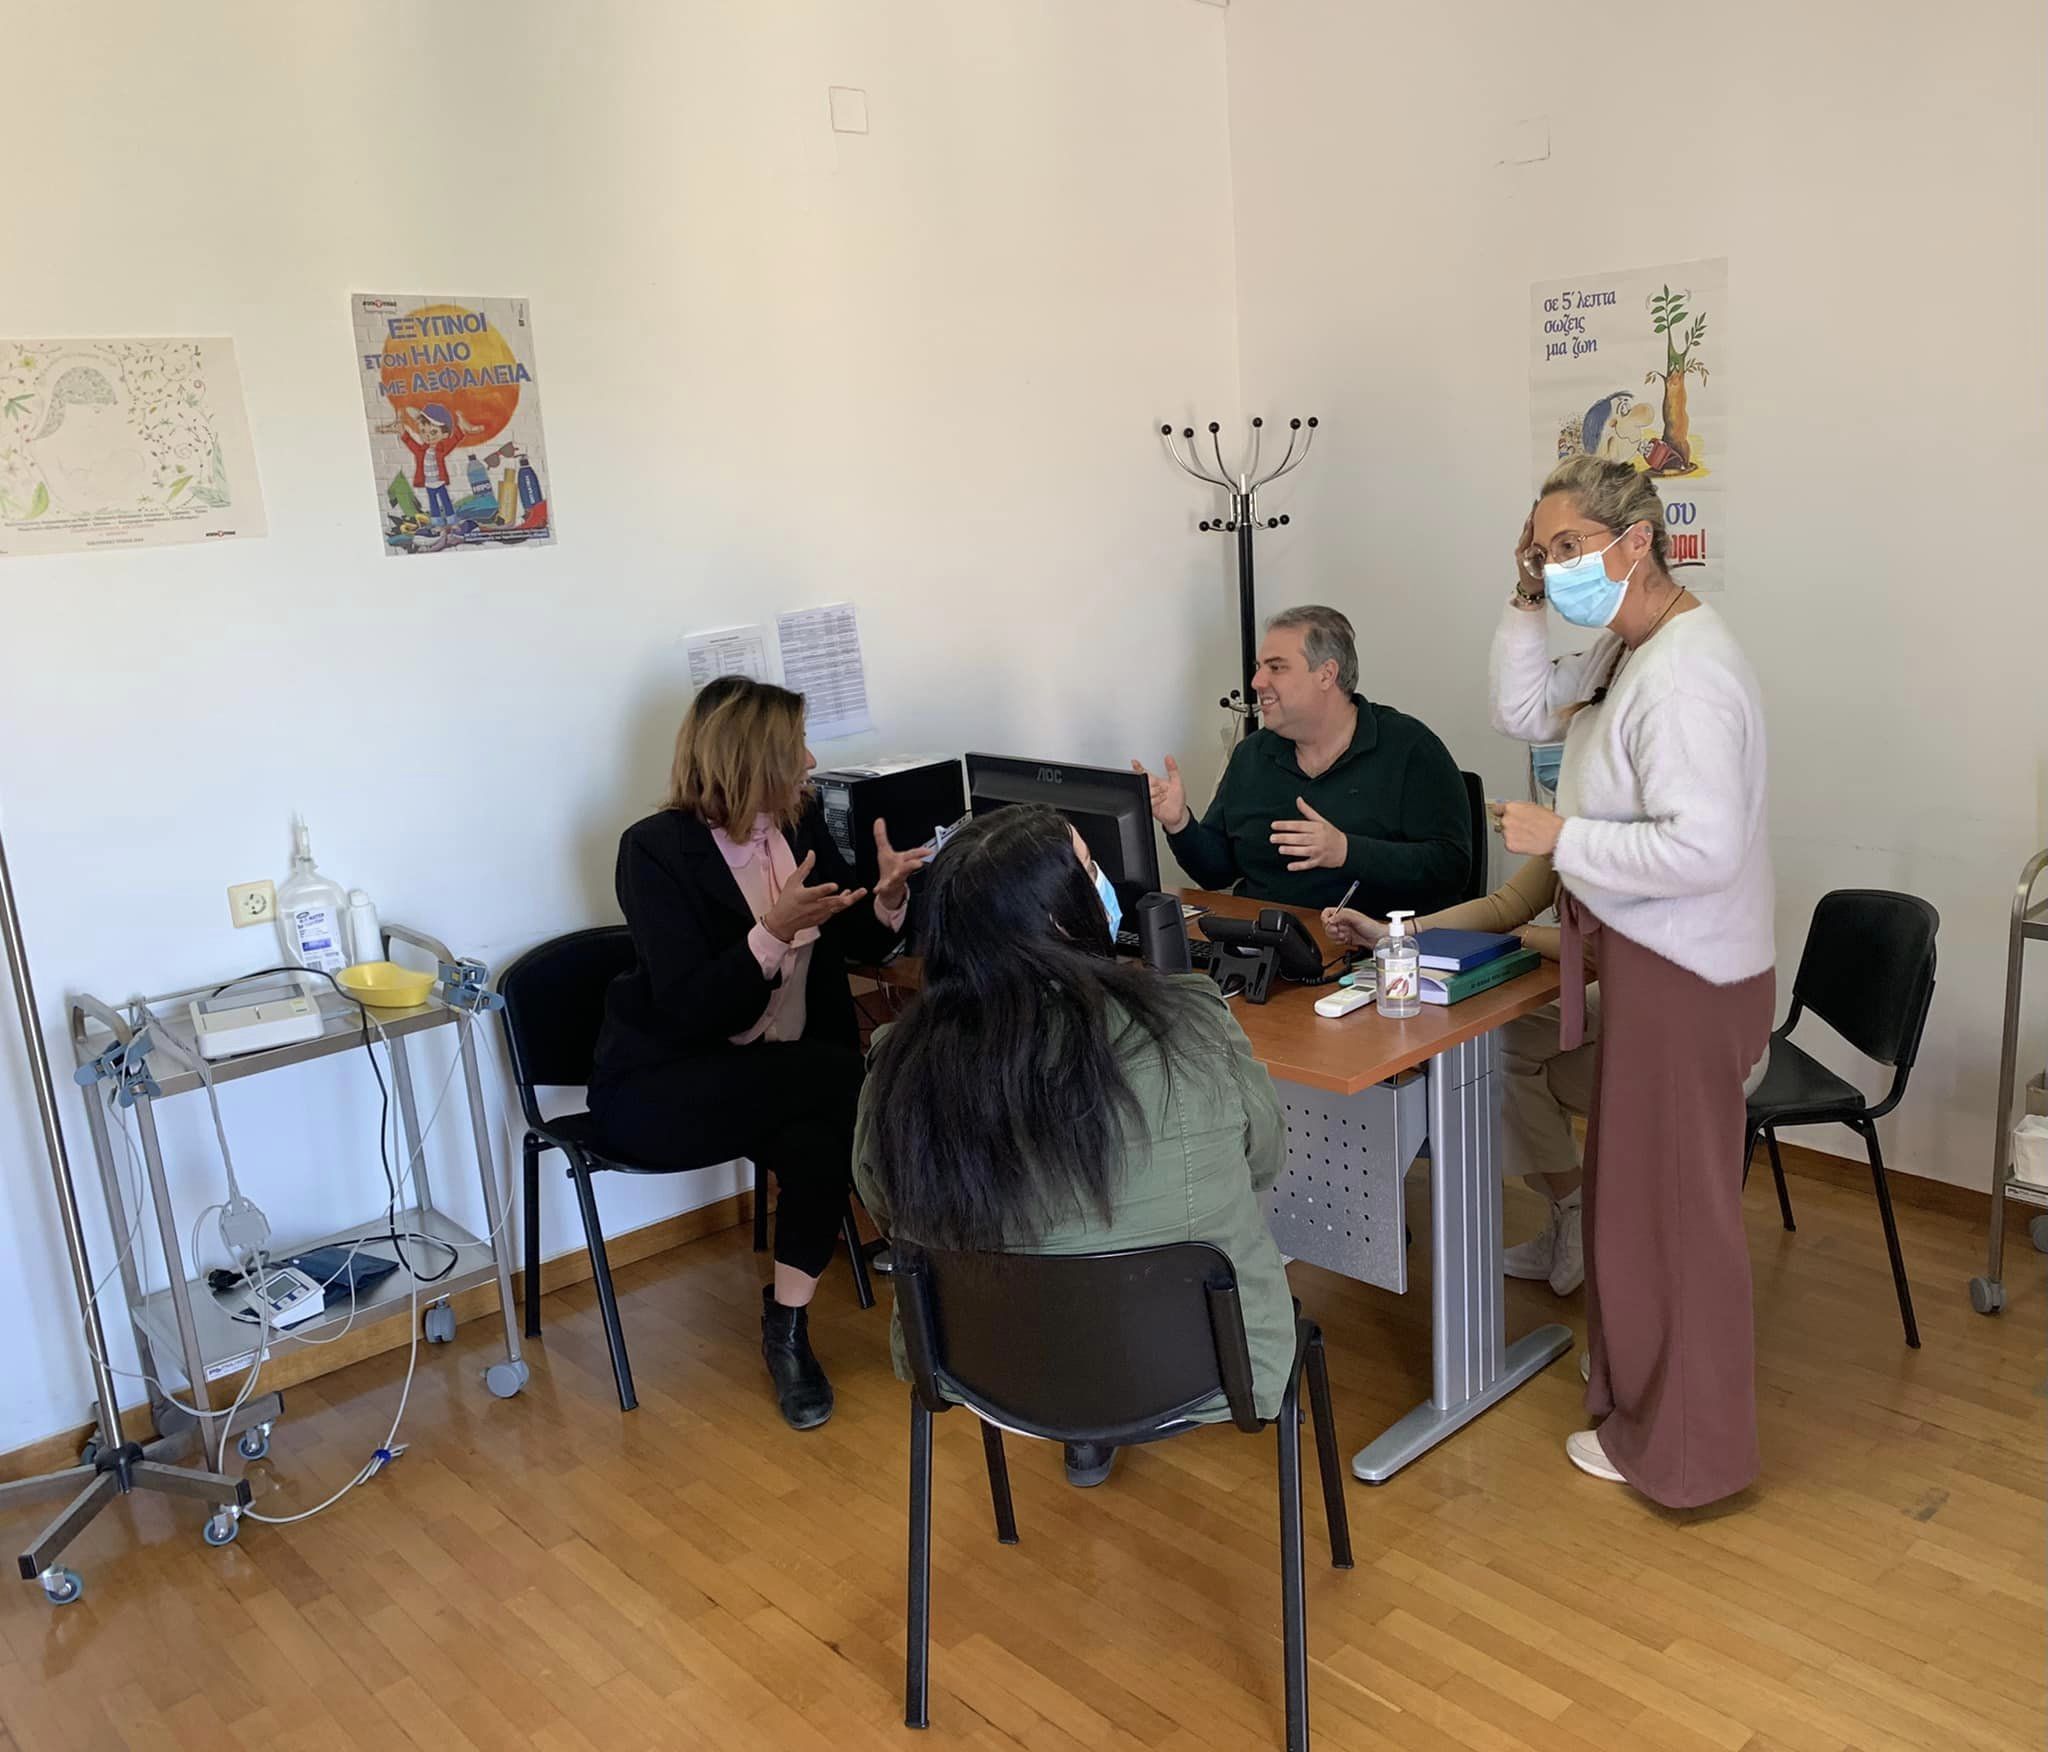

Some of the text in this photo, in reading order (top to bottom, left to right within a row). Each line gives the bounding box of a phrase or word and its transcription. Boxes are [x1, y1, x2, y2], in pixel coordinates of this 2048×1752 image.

[1544, 298, 1559, 313] σε
[1577, 290, 1616, 309] λεπτα
[387, 312, 488, 339] ΕΞΥΠΝΟΙ
[1544, 314, 1585, 336] σωζεις
[364, 342, 471, 370] ΣΤΟΝ ΗΛΙΟ
[1546, 336, 1597, 361] μια ζωη
[378, 363, 531, 397] ΜΕ ΑΣΦΑΛΕΙΑ
[1036, 767, 1063, 784] AOC
